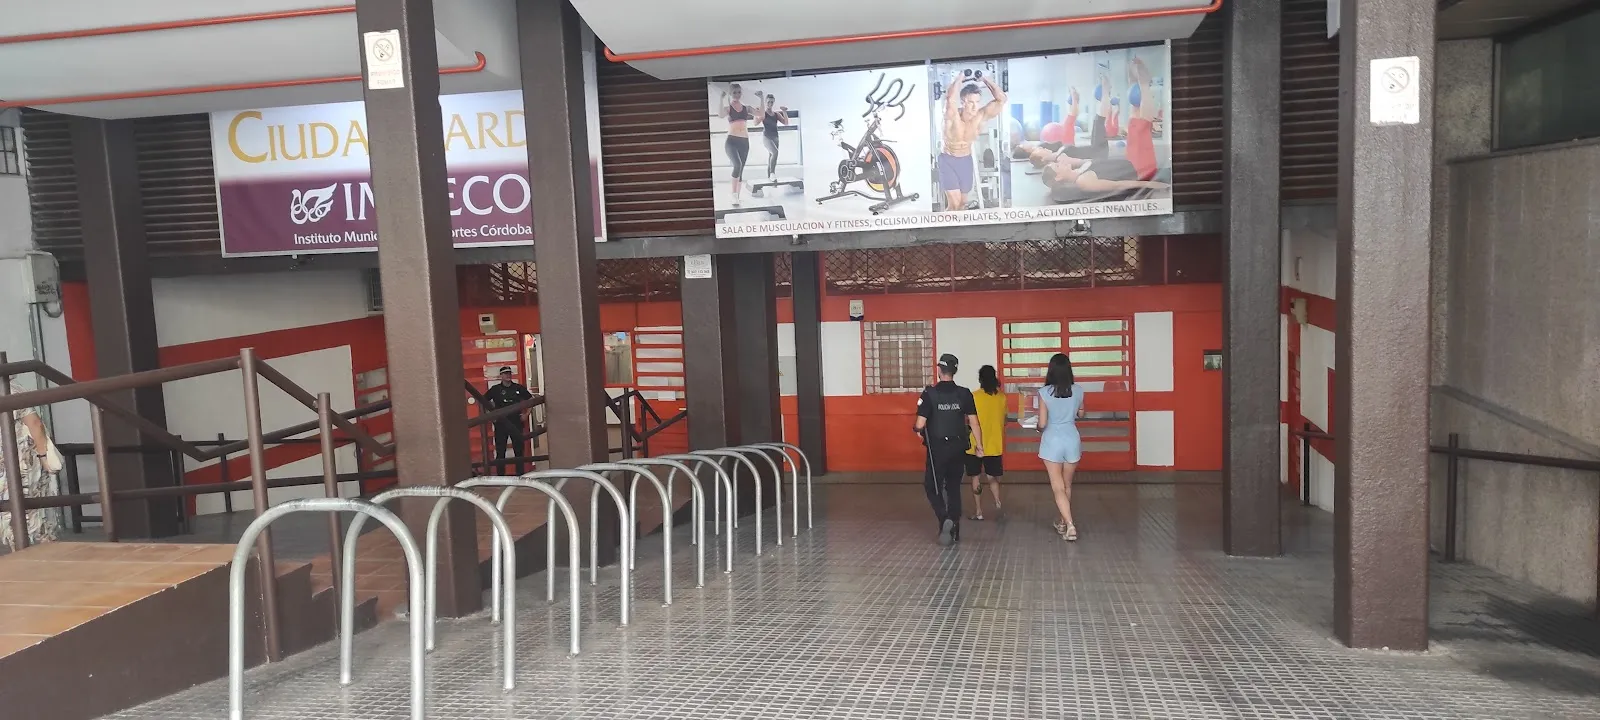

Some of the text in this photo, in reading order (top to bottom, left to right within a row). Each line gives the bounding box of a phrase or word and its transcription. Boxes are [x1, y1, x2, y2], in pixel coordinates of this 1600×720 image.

[228, 110, 527, 163] CIUDA ARD
[294, 232, 342, 245] Instituto
[344, 231, 378, 243] Munic
[480, 223, 532, 236] Córdoba
[722, 226, 744, 235] SALA
[746, 225, 757, 233] DE
[759, 222, 825, 232] MUSCULACION
[827, 221, 833, 229] Y
[835, 218, 872, 229] FITNESS,
[874, 216, 917, 227] CICLISMO
[920, 213, 961, 224] INDOOR,
[964, 212, 1001, 222] PILATES,
[1004, 210, 1034, 219] YOGA,
[1037, 205, 1100, 217] ACTIVIDADES
